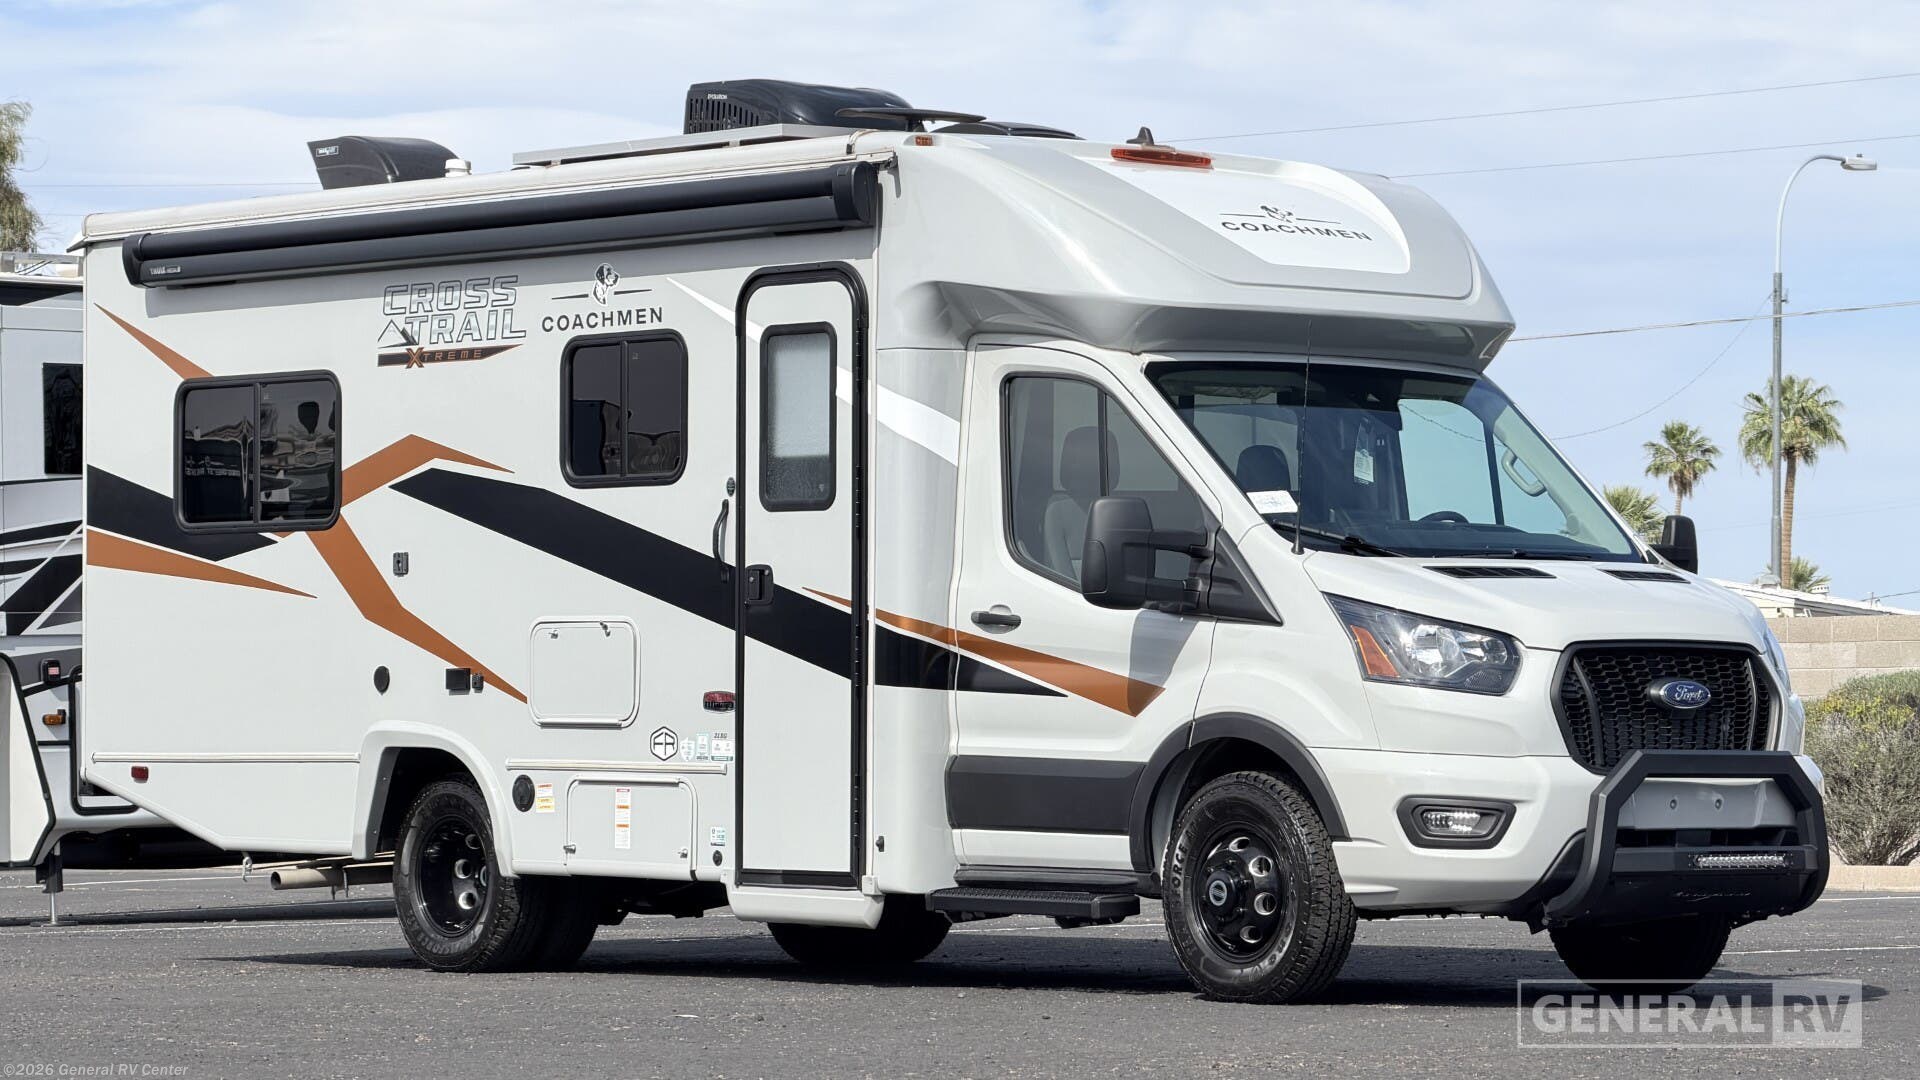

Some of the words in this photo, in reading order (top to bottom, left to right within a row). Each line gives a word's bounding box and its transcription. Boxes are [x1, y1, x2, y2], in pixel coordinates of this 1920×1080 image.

[1221, 221, 1373, 241] COACHMEN
[382, 274, 519, 316] CROSS
[404, 308, 527, 345] TRAIL
[541, 306, 663, 333] COACHMEN
[405, 347, 483, 369] XTREME
[1674, 684, 1704, 701] Ford
